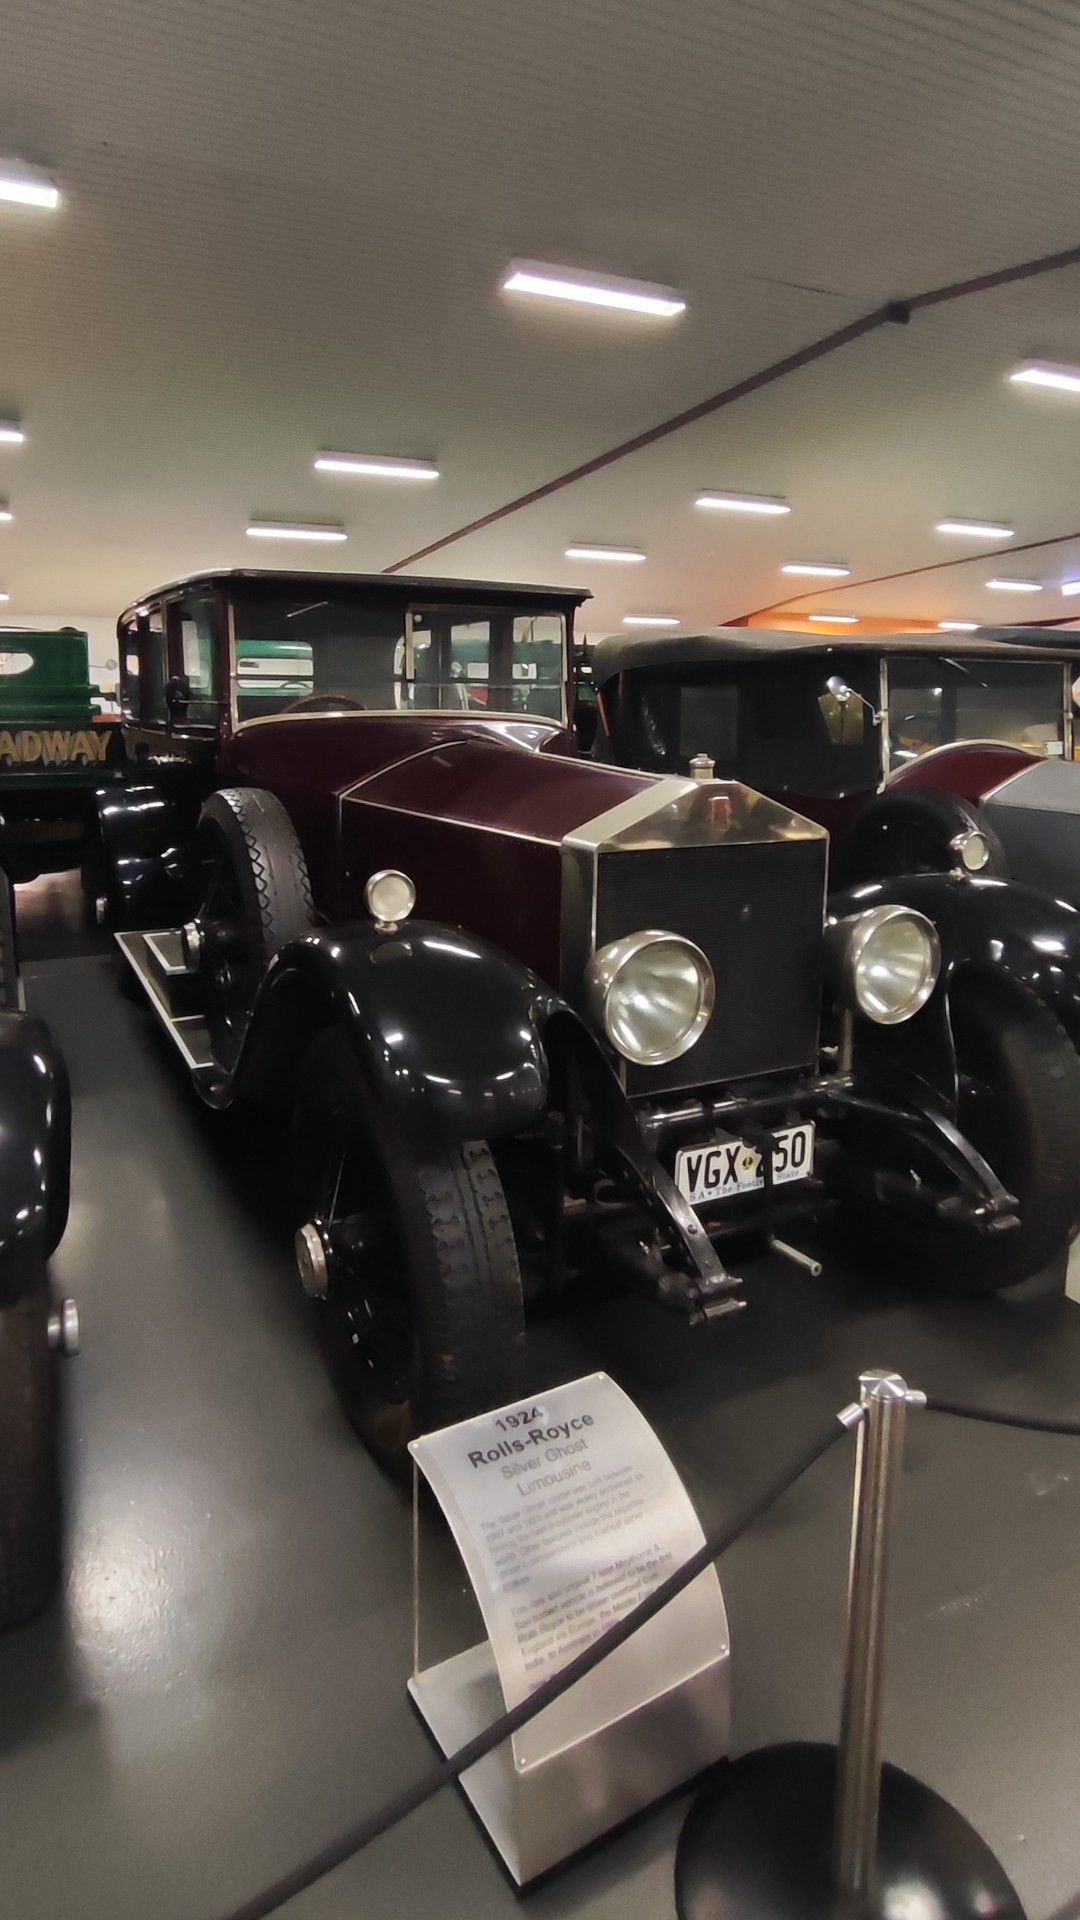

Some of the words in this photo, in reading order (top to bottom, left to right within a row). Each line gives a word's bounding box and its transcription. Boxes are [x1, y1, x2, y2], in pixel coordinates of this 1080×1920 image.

[687, 1145, 741, 1193] VGX
[737, 1180, 764, 1191] Festiv
[493, 1405, 544, 1431] 1924
[466, 1414, 594, 1468] Rolls-Royce
[500, 1456, 542, 1479] Silver
[543, 1438, 588, 1462] Ghost
[515, 1459, 591, 1497] Limousine
